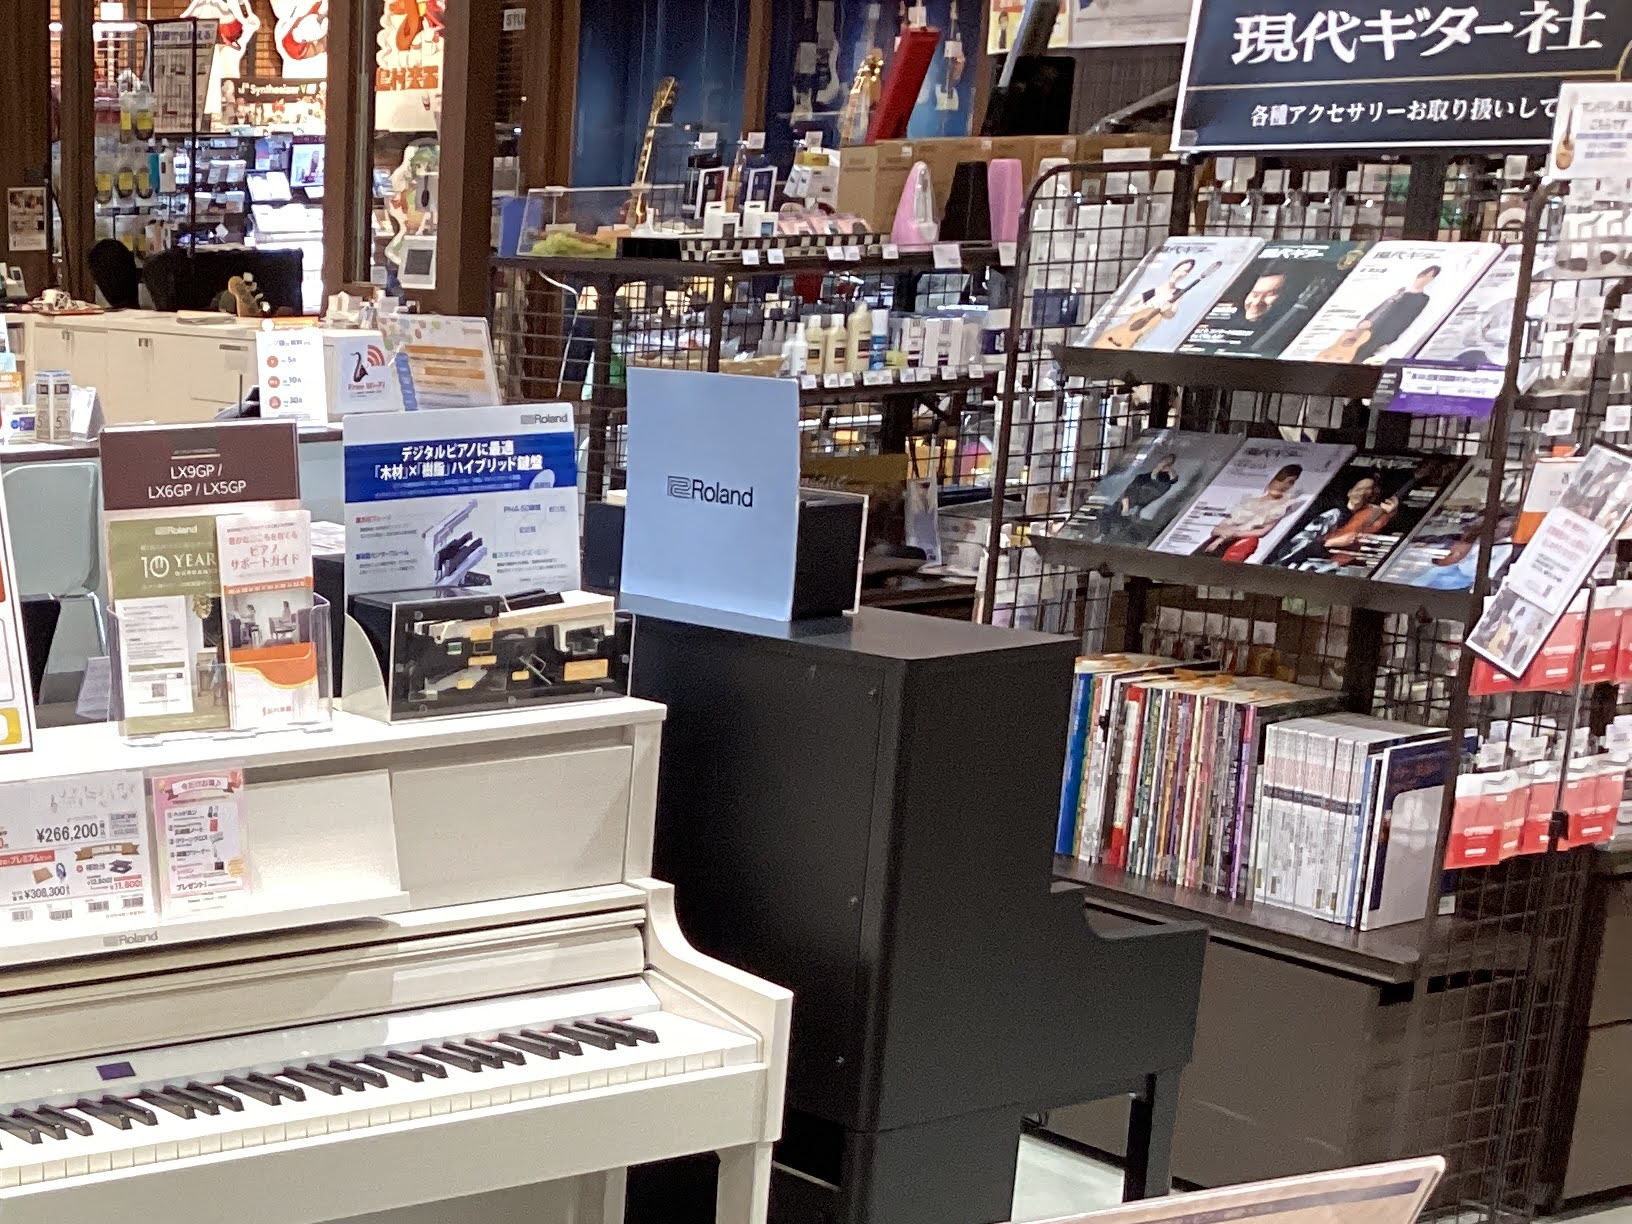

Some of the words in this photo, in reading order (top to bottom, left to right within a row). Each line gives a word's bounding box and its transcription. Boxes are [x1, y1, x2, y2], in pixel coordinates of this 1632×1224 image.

[1231, 0, 1608, 64] 現代ギター社
[1251, 97, 1558, 128] 各種アクセサリーお取り扱いして
[534, 413, 568, 424] Roland
[401, 440, 514, 462] デジタルピアノに最適
[170, 464, 215, 480] LX9GP
[148, 484, 193, 500] LX6GP
[203, 479, 247, 496] LX5GP
[692, 478, 754, 508] Roland
[230, 553, 301, 572] サポートガイド
[35, 822, 99, 843] ¥266,200
[24, 885, 66, 899] ¥308,300
[118, 931, 159, 945] Roland
